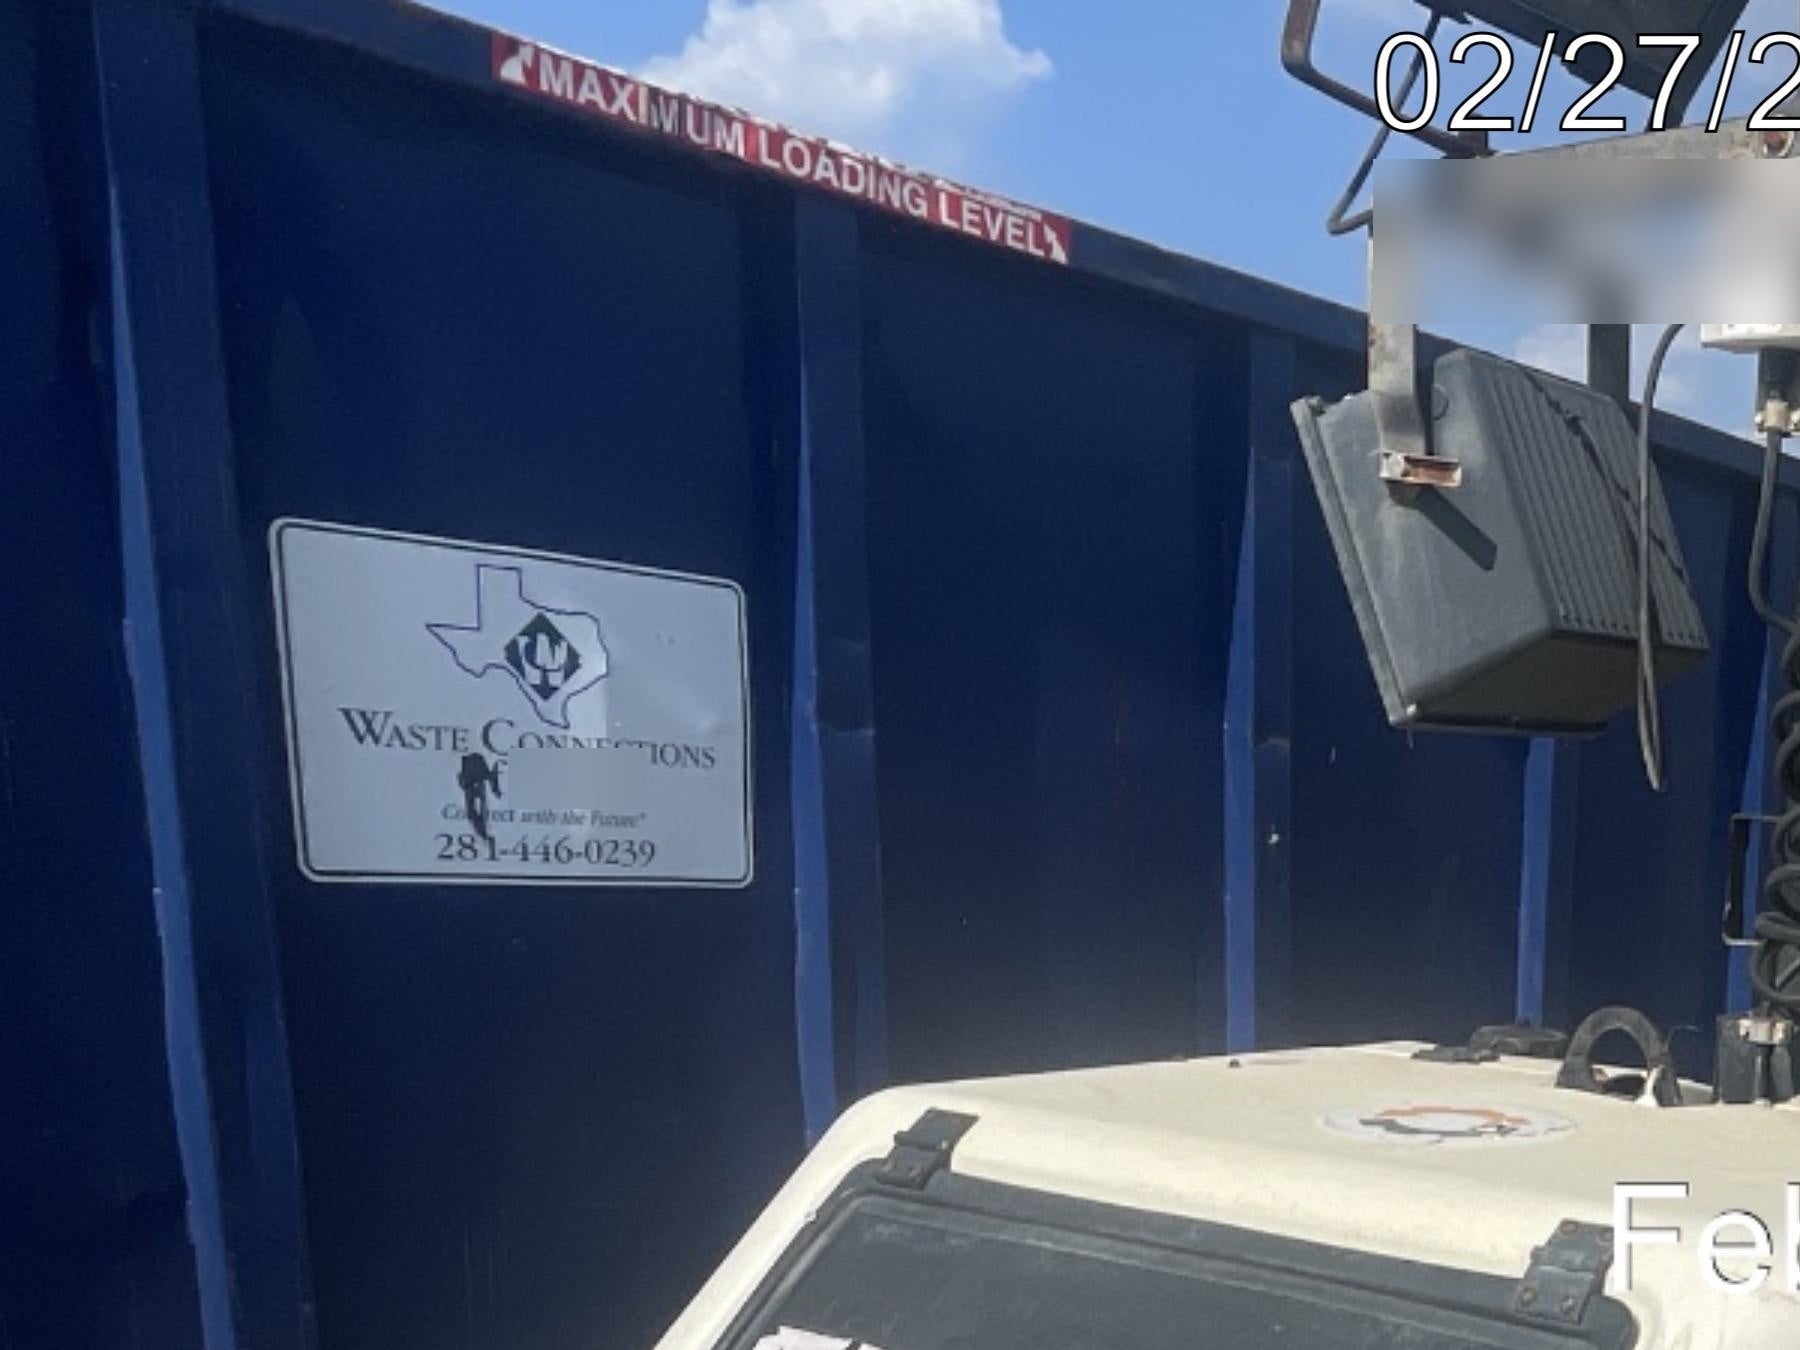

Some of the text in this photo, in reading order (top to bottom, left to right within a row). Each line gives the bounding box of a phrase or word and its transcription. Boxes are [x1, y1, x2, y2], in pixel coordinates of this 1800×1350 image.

[539, 52, 1044, 256] MAXIMUM LOADING LEVEL
[338, 707, 469, 754] WASTE
[435, 832, 656, 868] 281-446-0239
